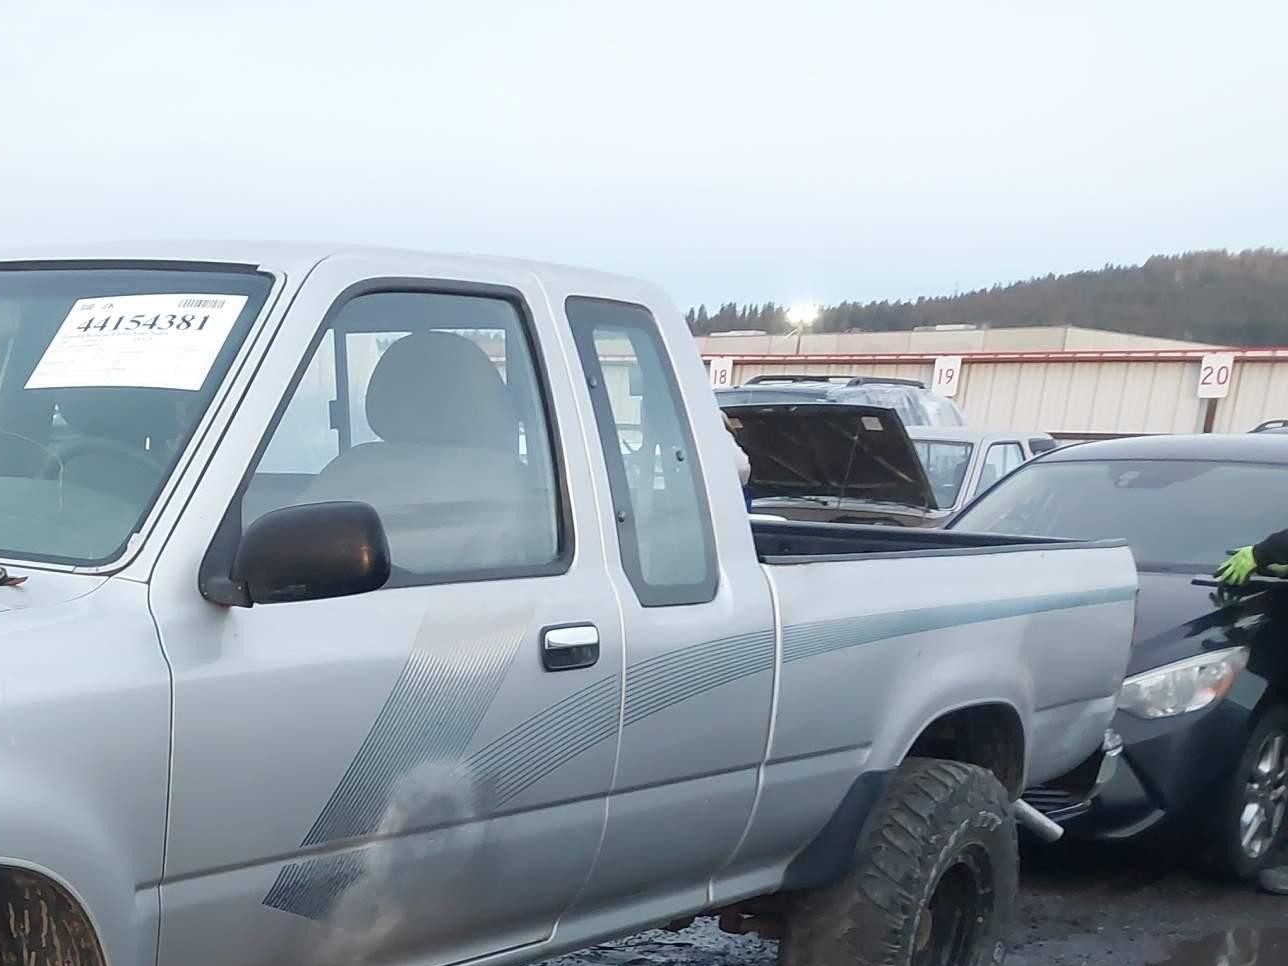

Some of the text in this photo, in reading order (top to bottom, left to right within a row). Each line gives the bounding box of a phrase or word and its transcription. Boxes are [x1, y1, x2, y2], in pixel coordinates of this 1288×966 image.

[77, 313, 211, 333] 44154381
[713, 368, 728, 385] 18
[937, 367, 955, 385] 19
[1200, 365, 1229, 385] 20
